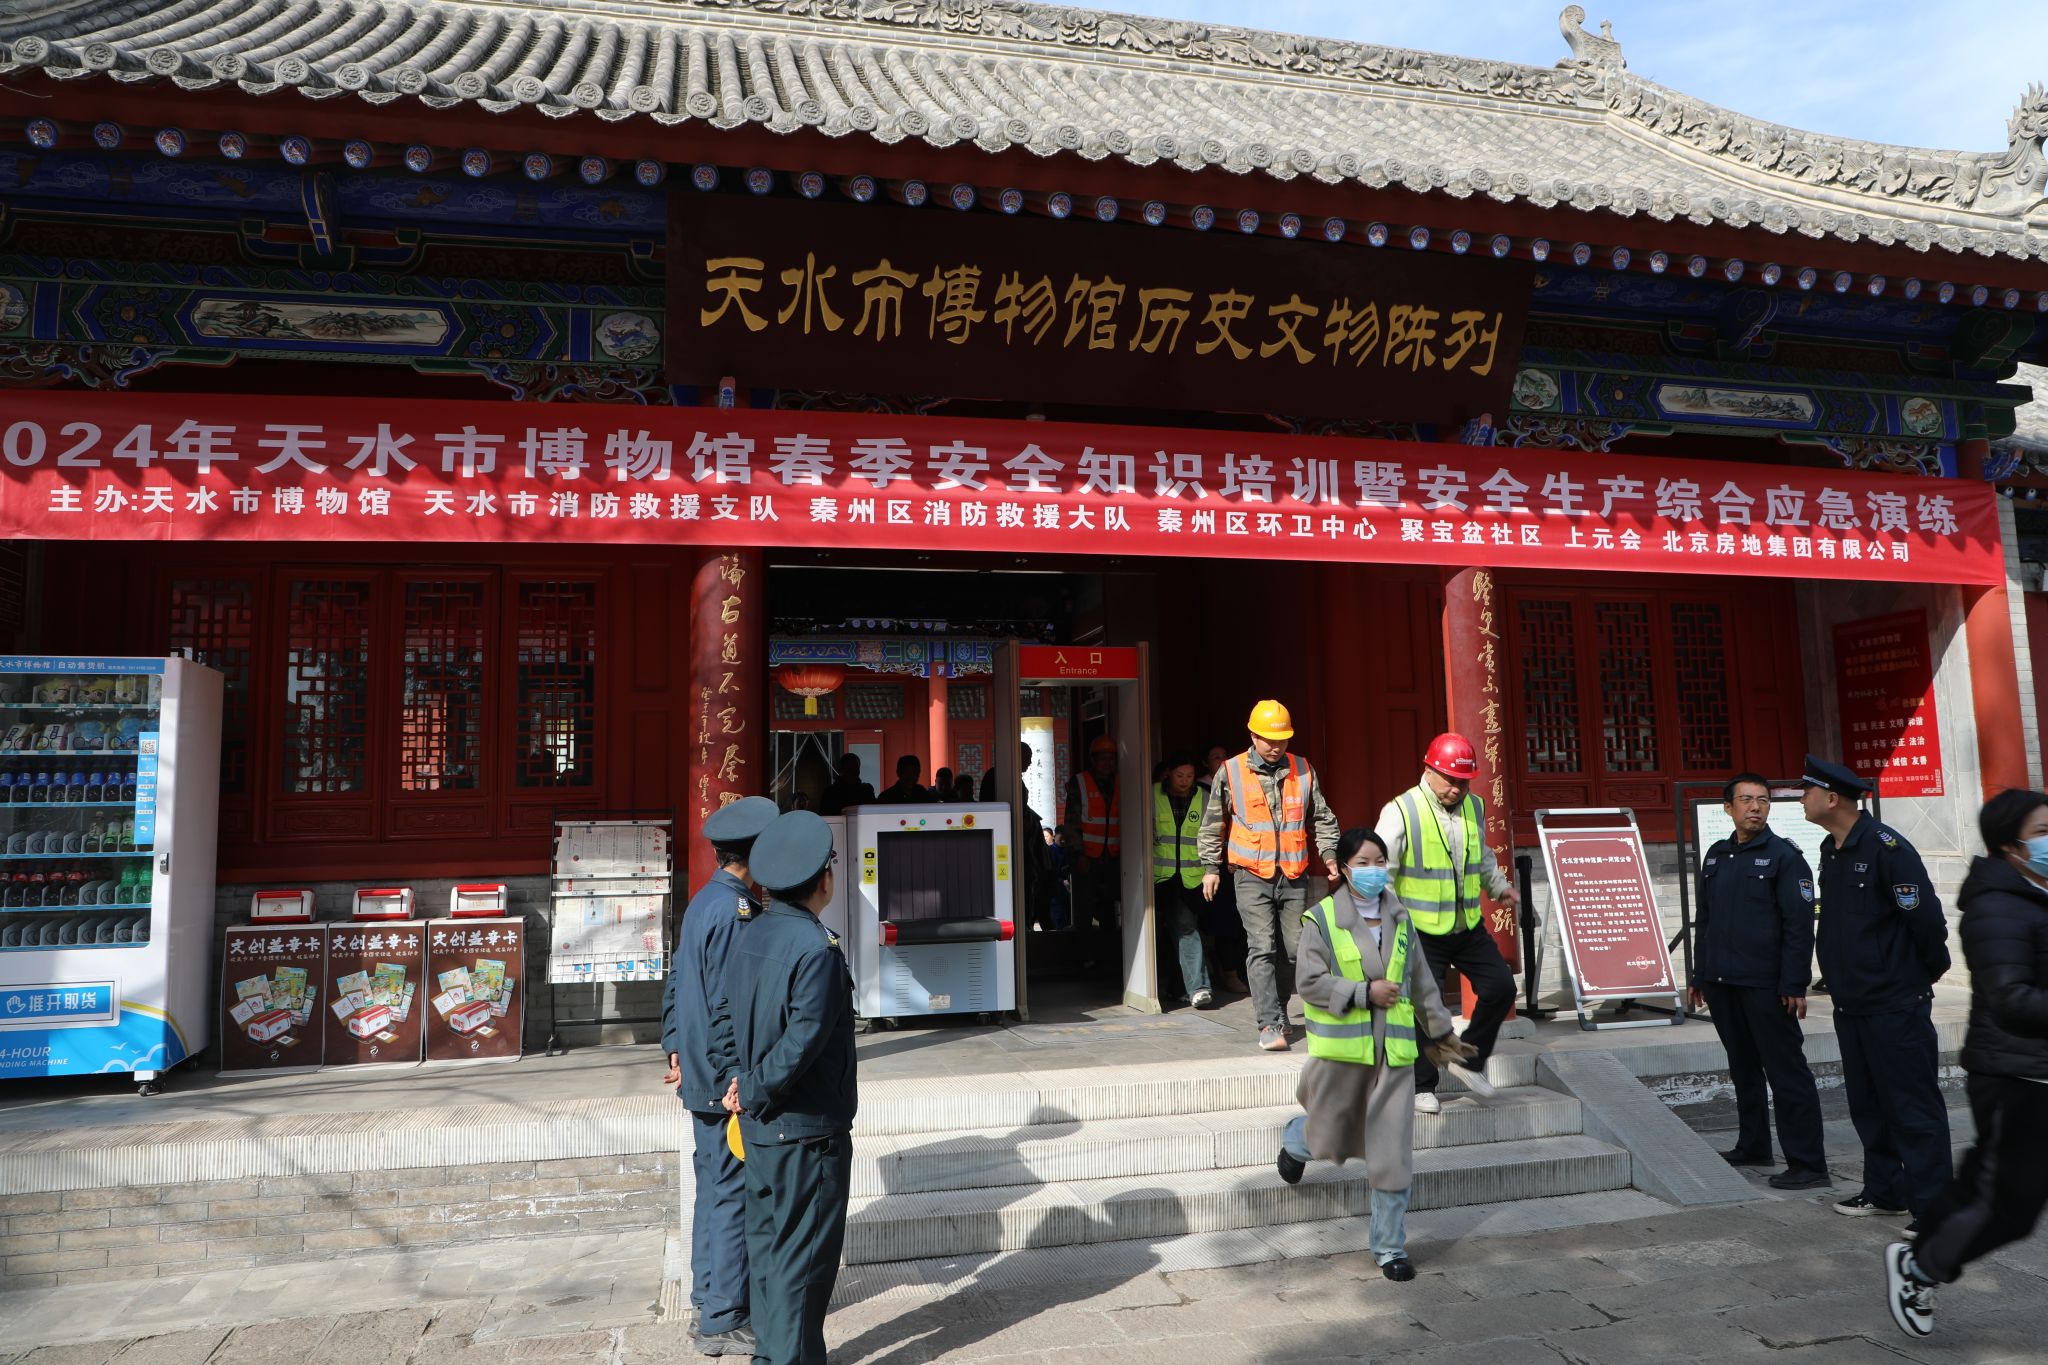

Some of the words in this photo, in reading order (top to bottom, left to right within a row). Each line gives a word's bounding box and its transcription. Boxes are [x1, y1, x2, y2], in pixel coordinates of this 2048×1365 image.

[700, 250, 1503, 376] 天水市博物馆历史文物陈列
[424, 488, 779, 522] 天水市消防救援支队
[809, 496, 1131, 531] 秦州区消防救援大队
[1157, 508, 1377, 540] 秦州区环卫中心
[1401, 518, 1542, 547] 聚宝盆社区
[1564, 525, 1642, 550] 上元会
[1662, 531, 1910, 563] 北京房地集团有限公司
[1054, 651, 1102, 665] 入口
[1059, 666, 1098, 675] Entrance
[1908, 716, 1924, 727] 和谐
[1890, 737, 1906, 748] 公正
[1909, 736, 1925, 746] 法治
[1892, 757, 1908, 767] 诚信
[1911, 755, 1927, 766] 友善
[230, 936, 321, 955] 文创盖章卡
[332, 933, 419, 951] 文创盖章卡
[432, 929, 518, 947] 文创盖章卡
[28, 991, 97, 1012] 推开取货
[29, 1058, 69, 1067] MACHINE
